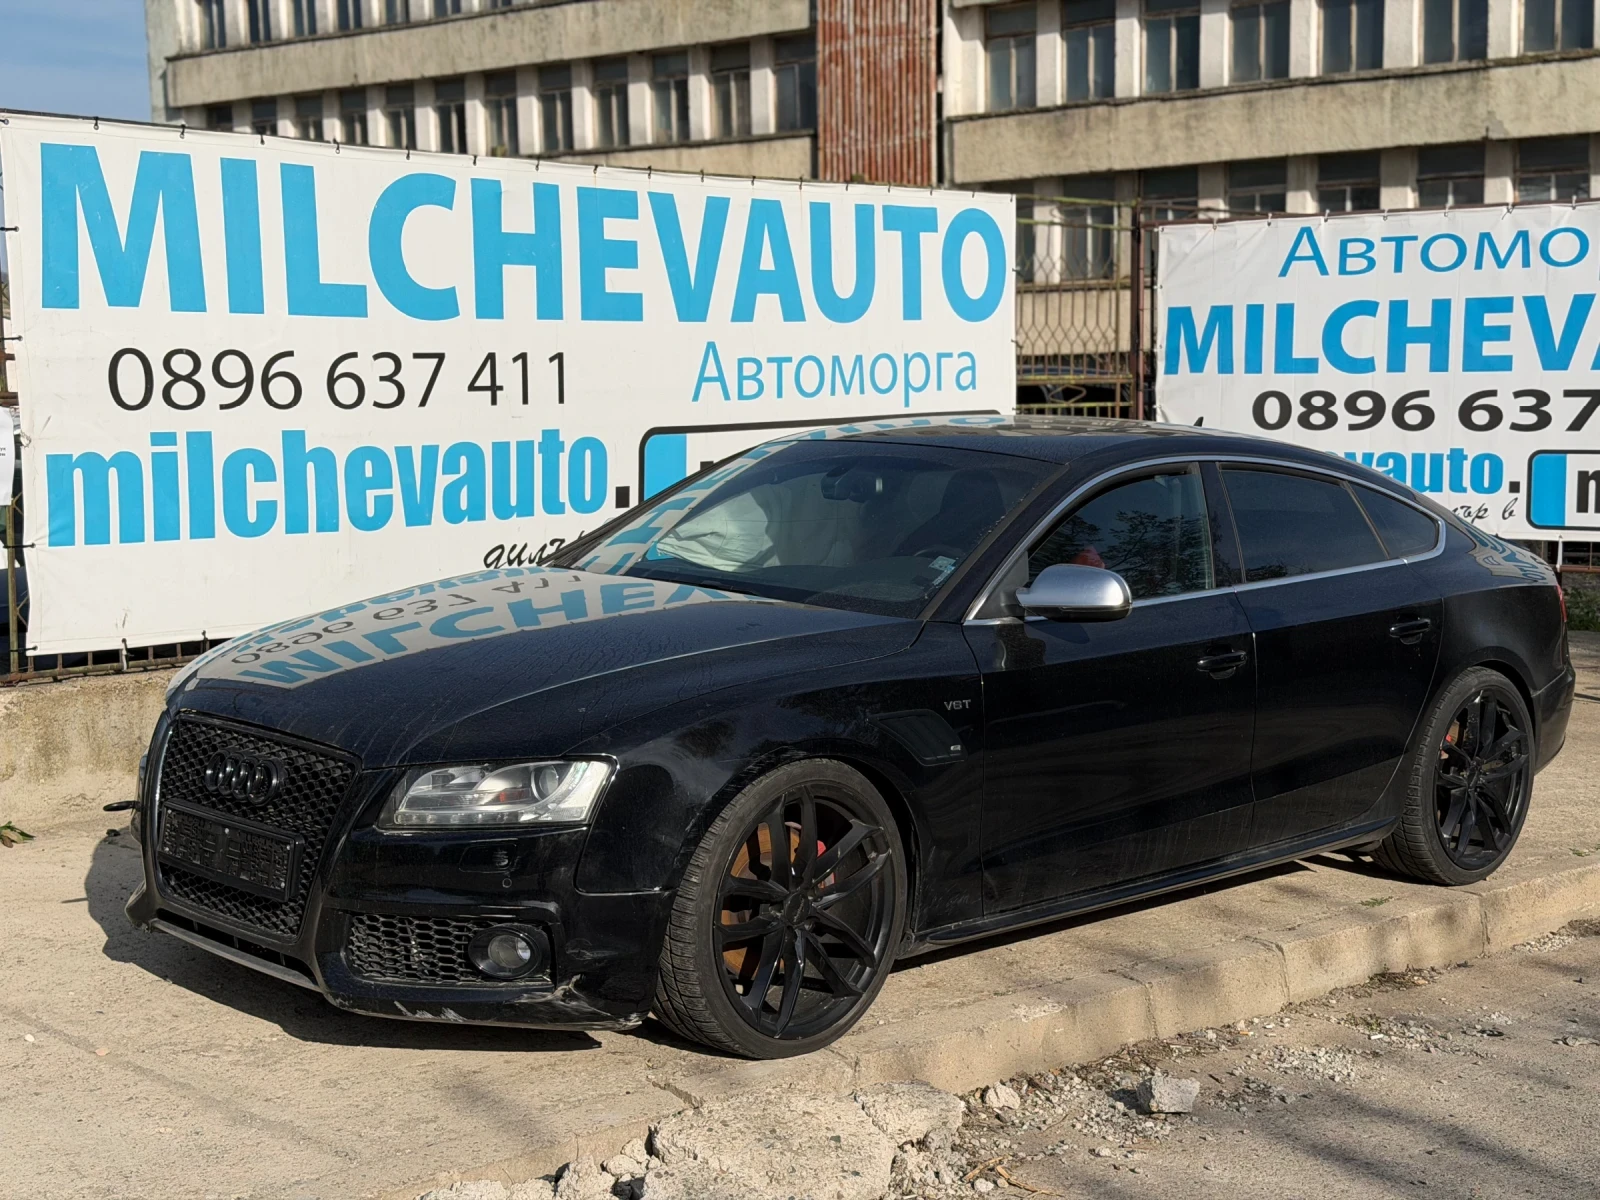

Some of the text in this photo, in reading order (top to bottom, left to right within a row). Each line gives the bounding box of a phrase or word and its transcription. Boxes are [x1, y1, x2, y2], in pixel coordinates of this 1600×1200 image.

[41, 143, 1007, 324] MILCHEVAUTO
[1278, 226, 1600, 281] Автомо
[1163, 292, 1600, 375] MILCHEV
[108, 347, 565, 411] 0896 637 411
[692, 341, 977, 408] Автоморга
[1252, 389, 1600, 432] 0896 637
